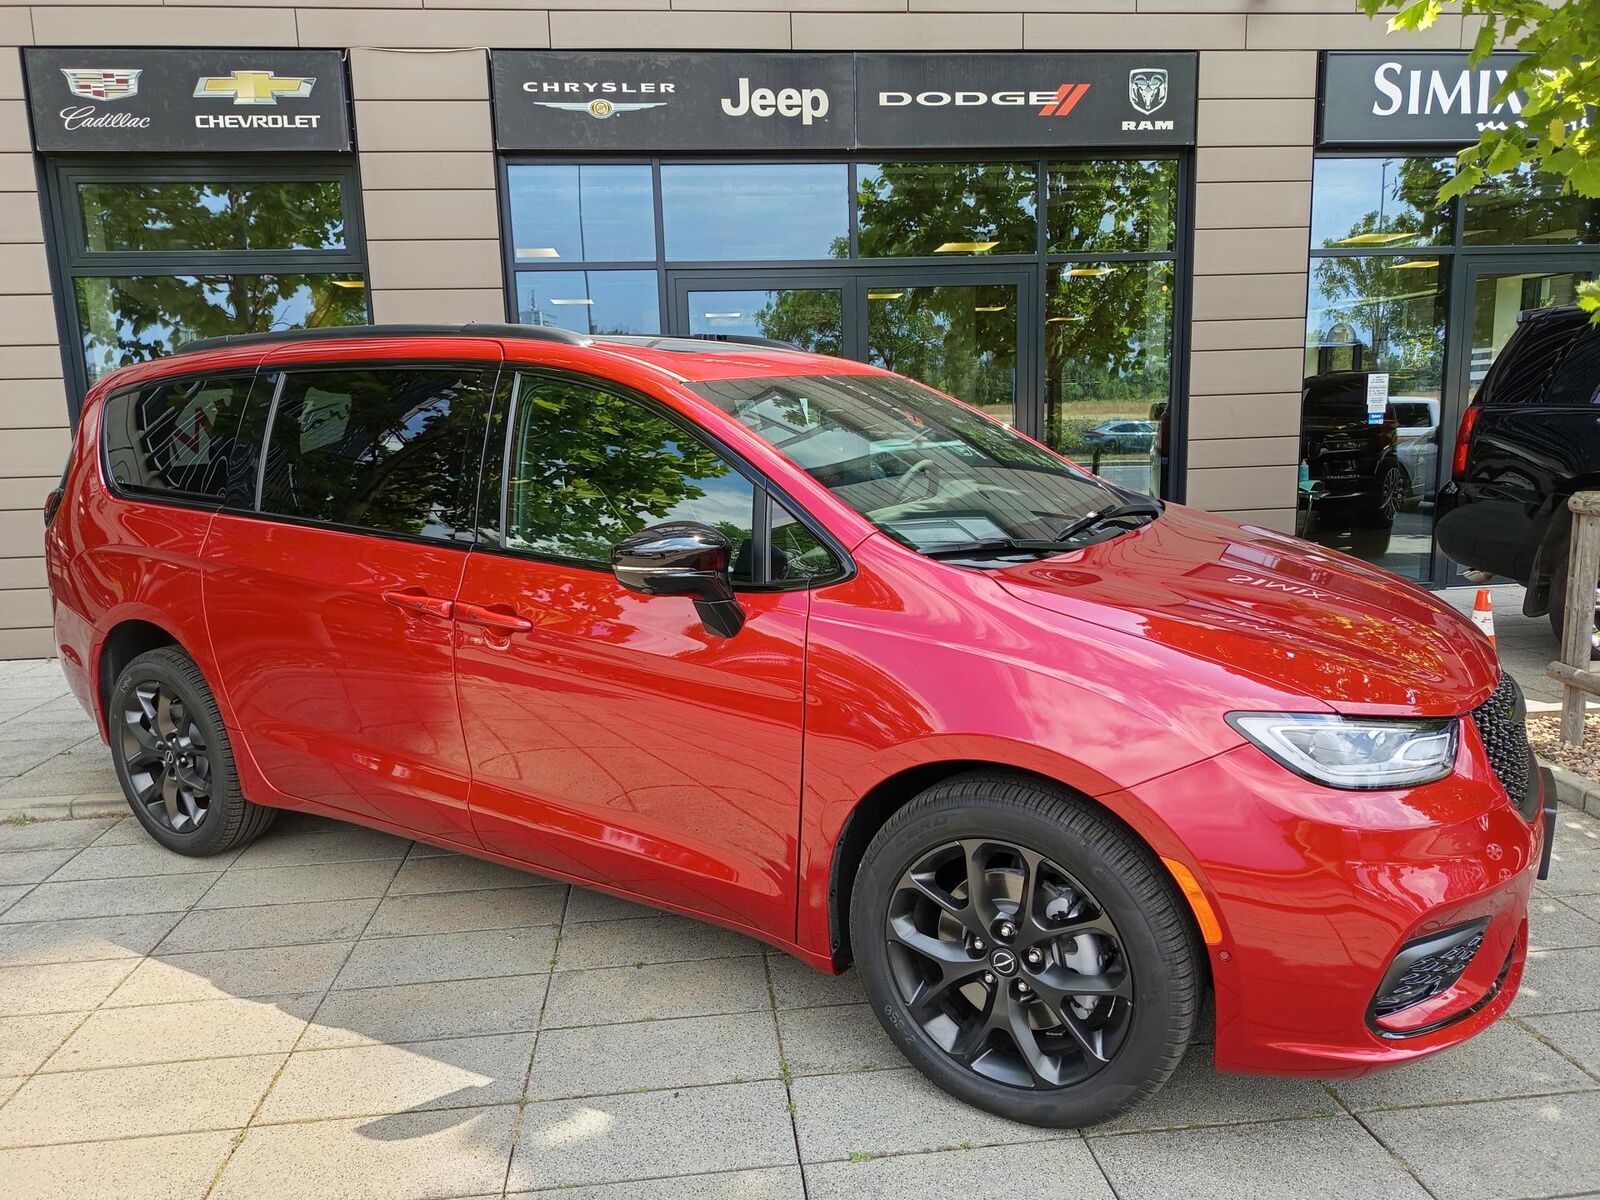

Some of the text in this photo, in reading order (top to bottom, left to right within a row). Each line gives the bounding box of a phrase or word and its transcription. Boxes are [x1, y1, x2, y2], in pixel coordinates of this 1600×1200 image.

[522, 82, 677, 94] CHRYSLER
[721, 77, 829, 125] Jeep
[878, 91, 1060, 107] DODGE
[59, 105, 151, 131] Cadillac
[194, 114, 321, 129] CHEVROLET
[1121, 120, 1174, 131] RAM
